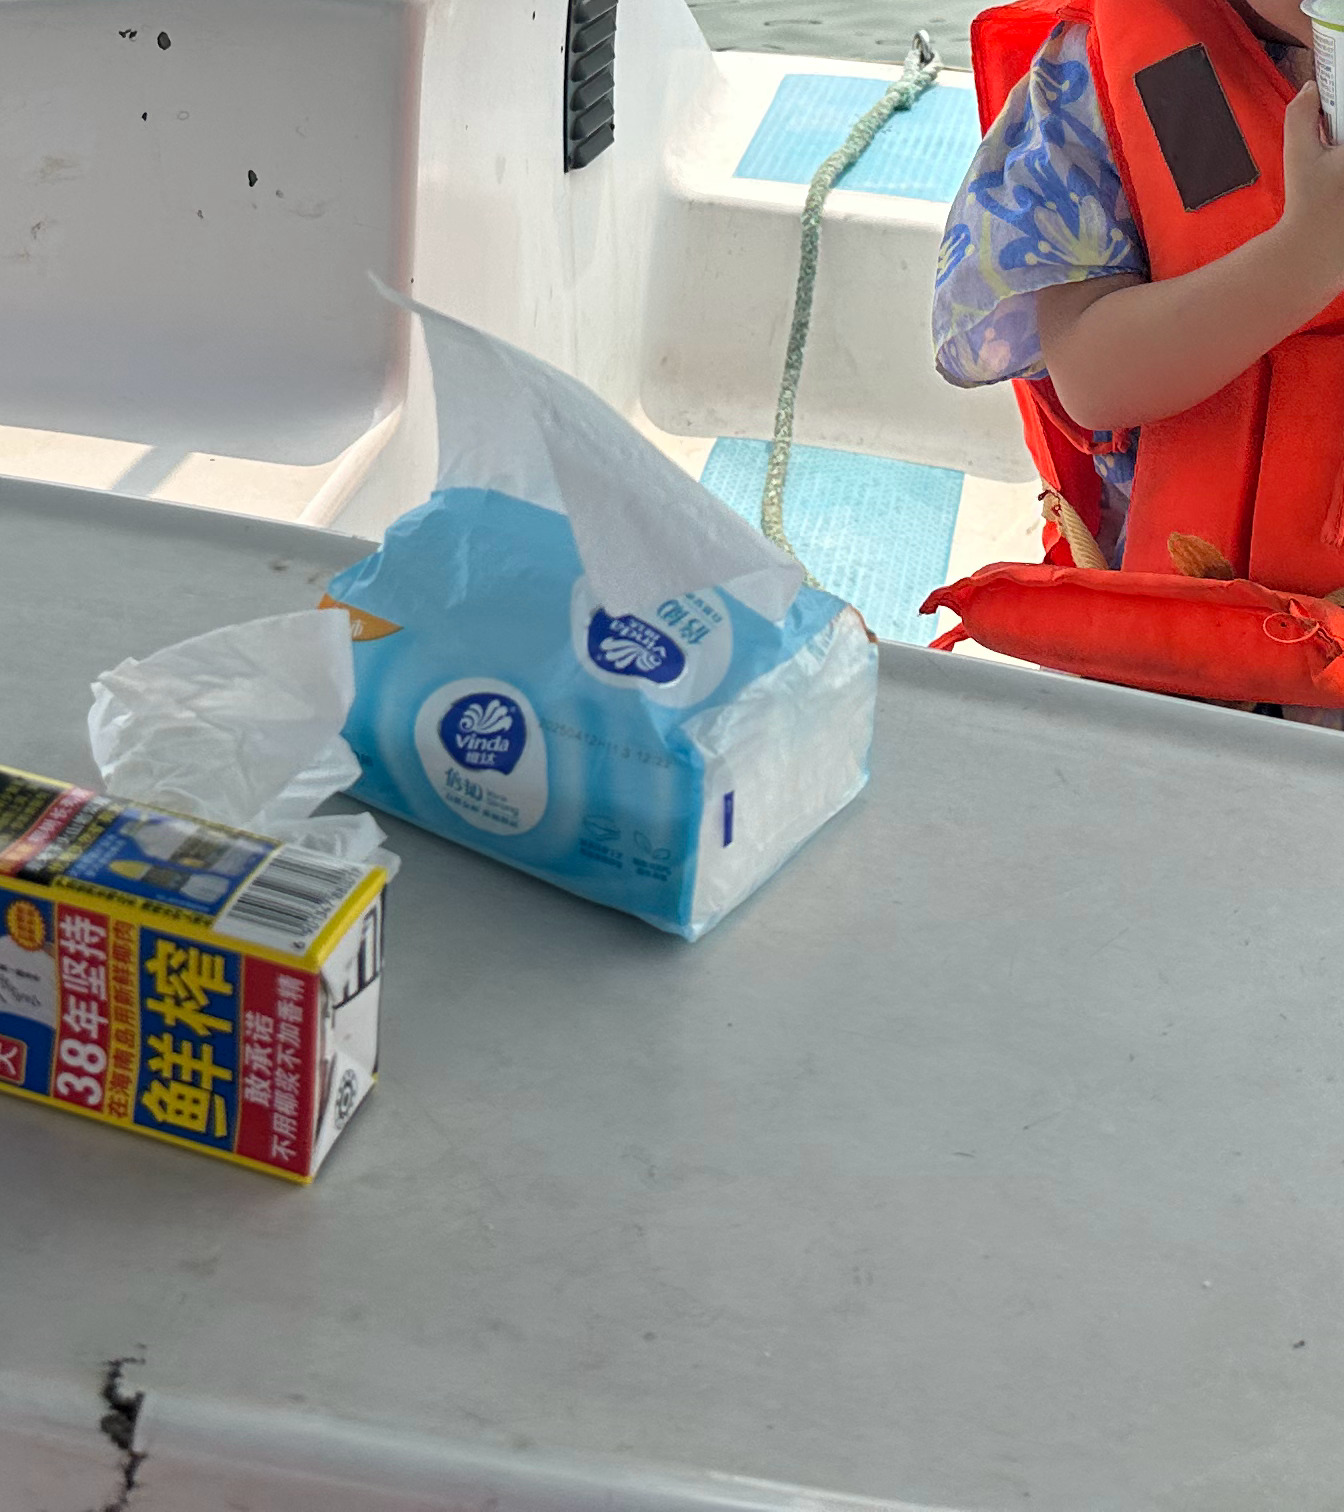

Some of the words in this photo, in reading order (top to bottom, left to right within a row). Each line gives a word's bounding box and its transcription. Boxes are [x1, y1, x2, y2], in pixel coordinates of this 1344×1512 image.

[455, 733, 510, 752] Vinda
[465, 751, 497, 765] 维达
[56, 914, 109, 1107] 38年坚持
[108, 919, 136, 1119] 在海南岛用新鲜椰肉
[141, 937, 234, 1139] 鲜榨
[244, 1009, 274, 1108] 敢承诺
[271, 974, 306, 1161] 不用椰浆不加香精
